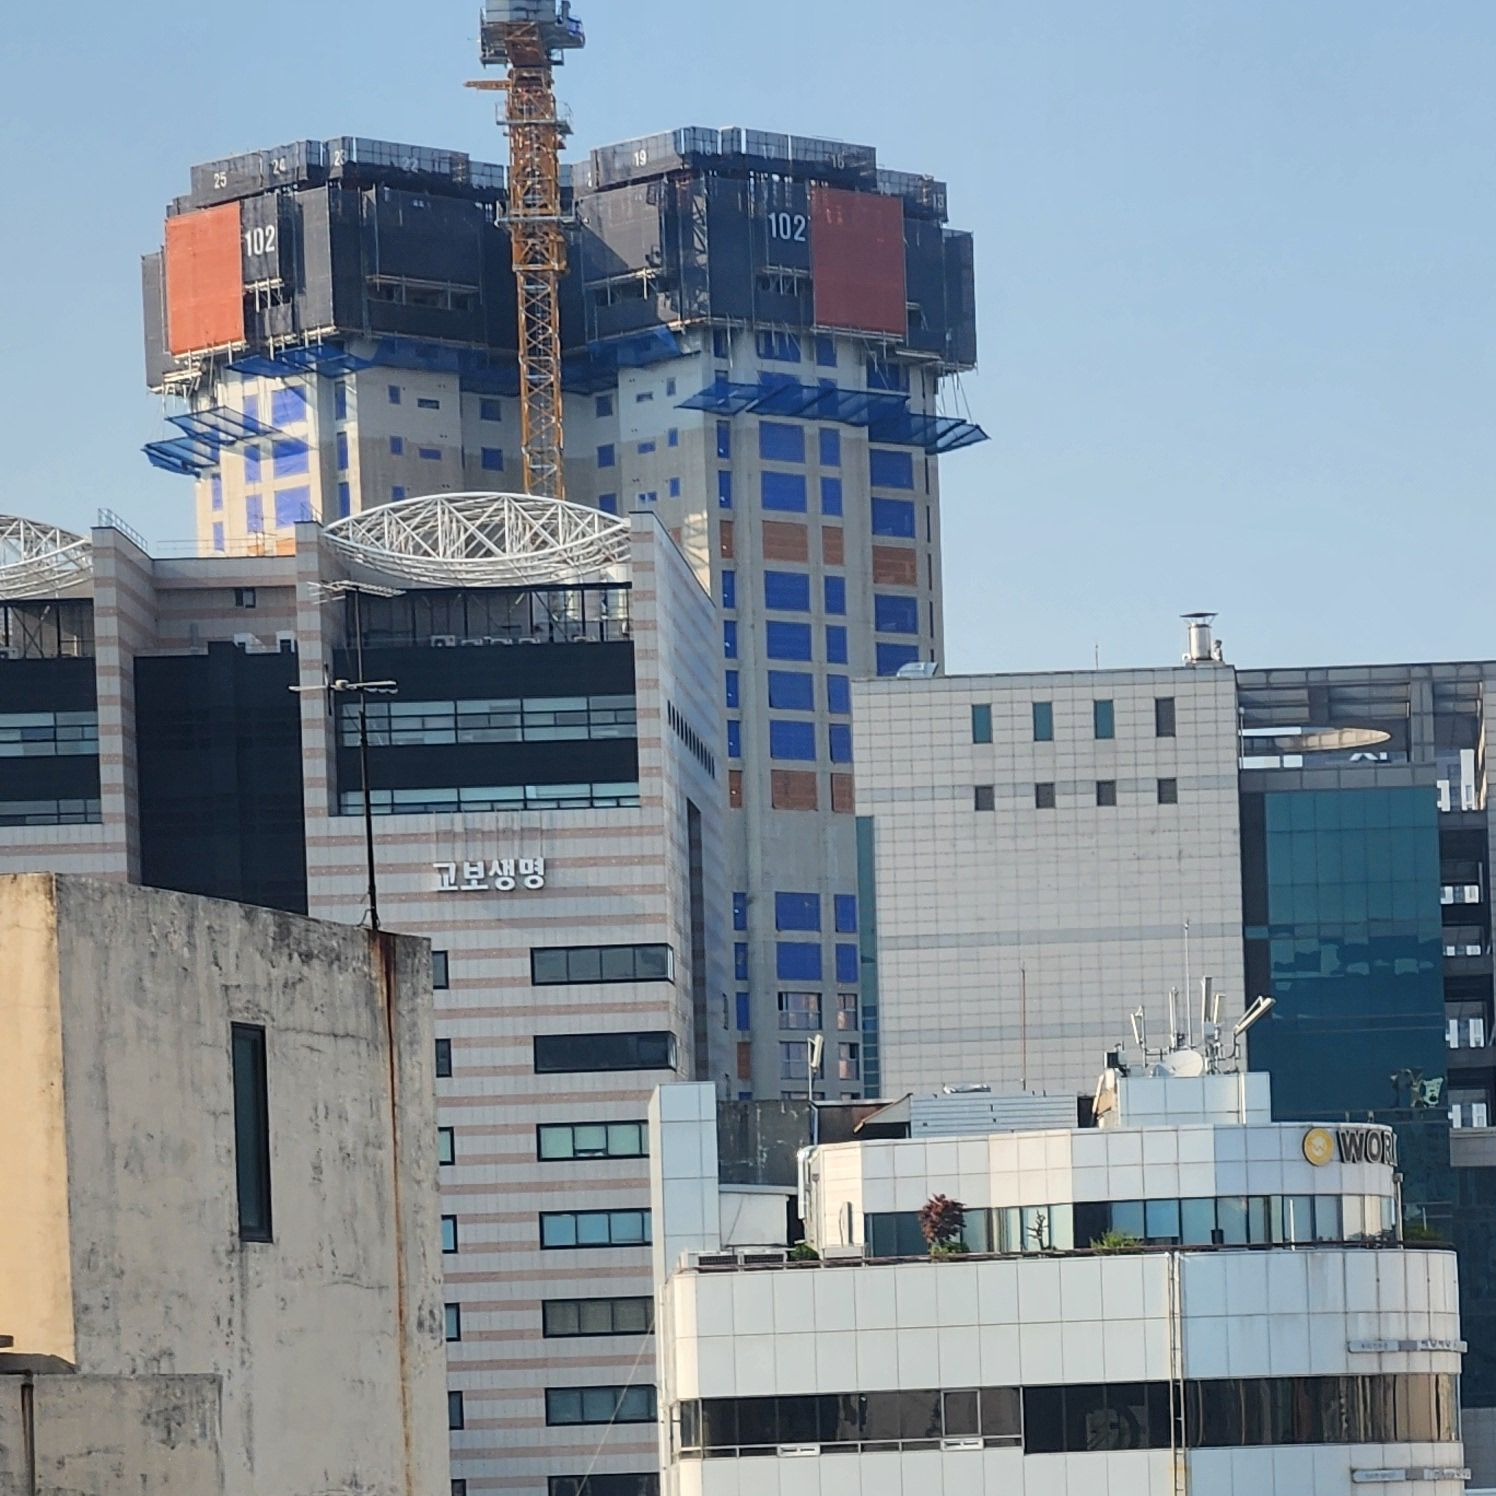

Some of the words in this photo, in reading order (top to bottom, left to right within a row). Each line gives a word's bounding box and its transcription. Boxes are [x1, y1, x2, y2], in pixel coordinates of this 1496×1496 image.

[272, 157, 287, 175] 24
[402, 157, 419, 174] 22
[633, 150, 647, 168] 19
[213, 171, 228, 189] 25
[769, 212, 807, 242] 102
[244, 224, 276, 257] 102
[432, 856, 545, 892] 교보생명
